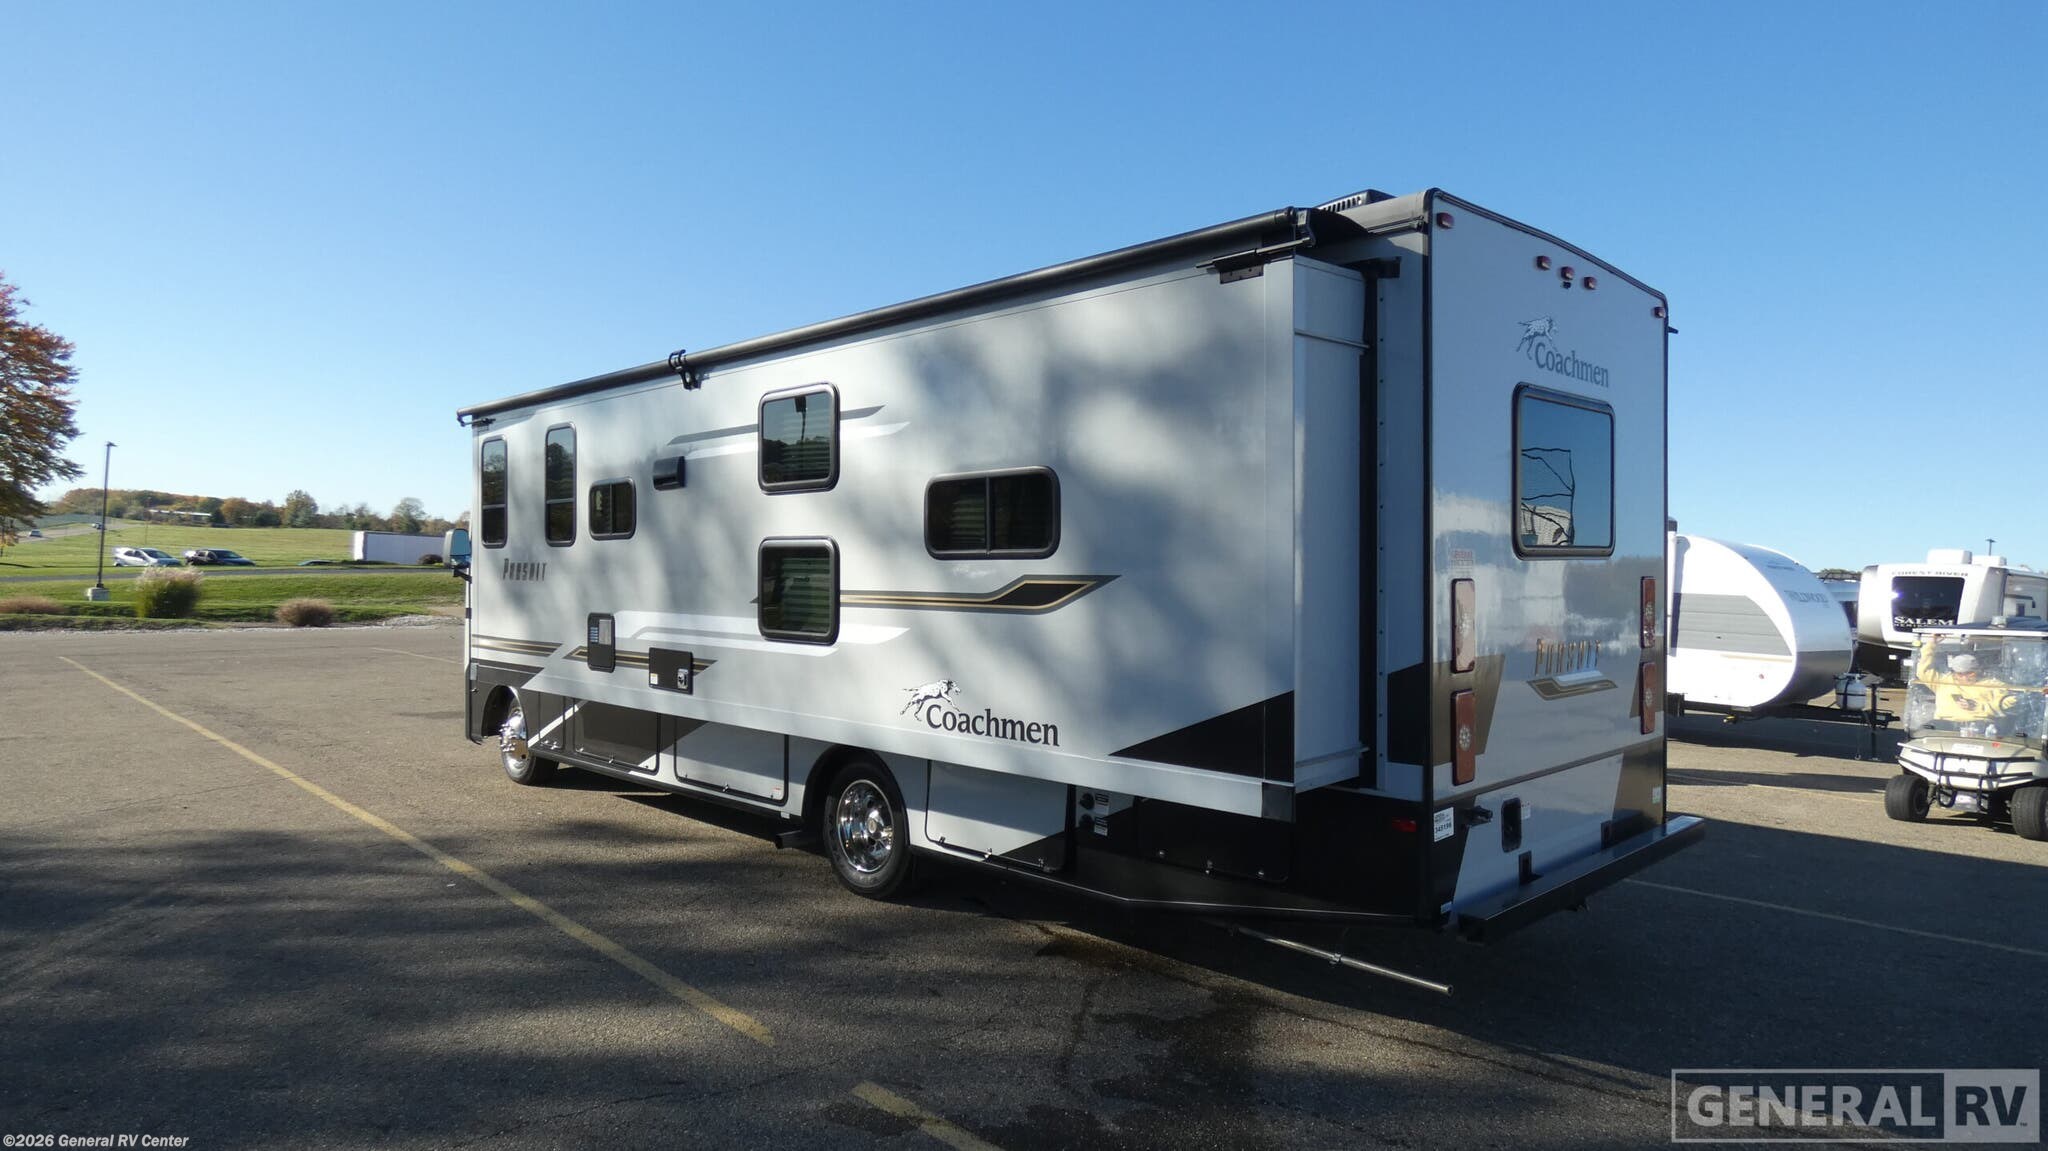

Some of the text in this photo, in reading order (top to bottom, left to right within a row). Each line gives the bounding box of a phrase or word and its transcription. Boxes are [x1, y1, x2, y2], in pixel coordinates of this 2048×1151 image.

[1535, 342, 1608, 388] Coachmen
[1893, 615, 1955, 626] SALEM
[926, 703, 1060, 747] Coachmen
